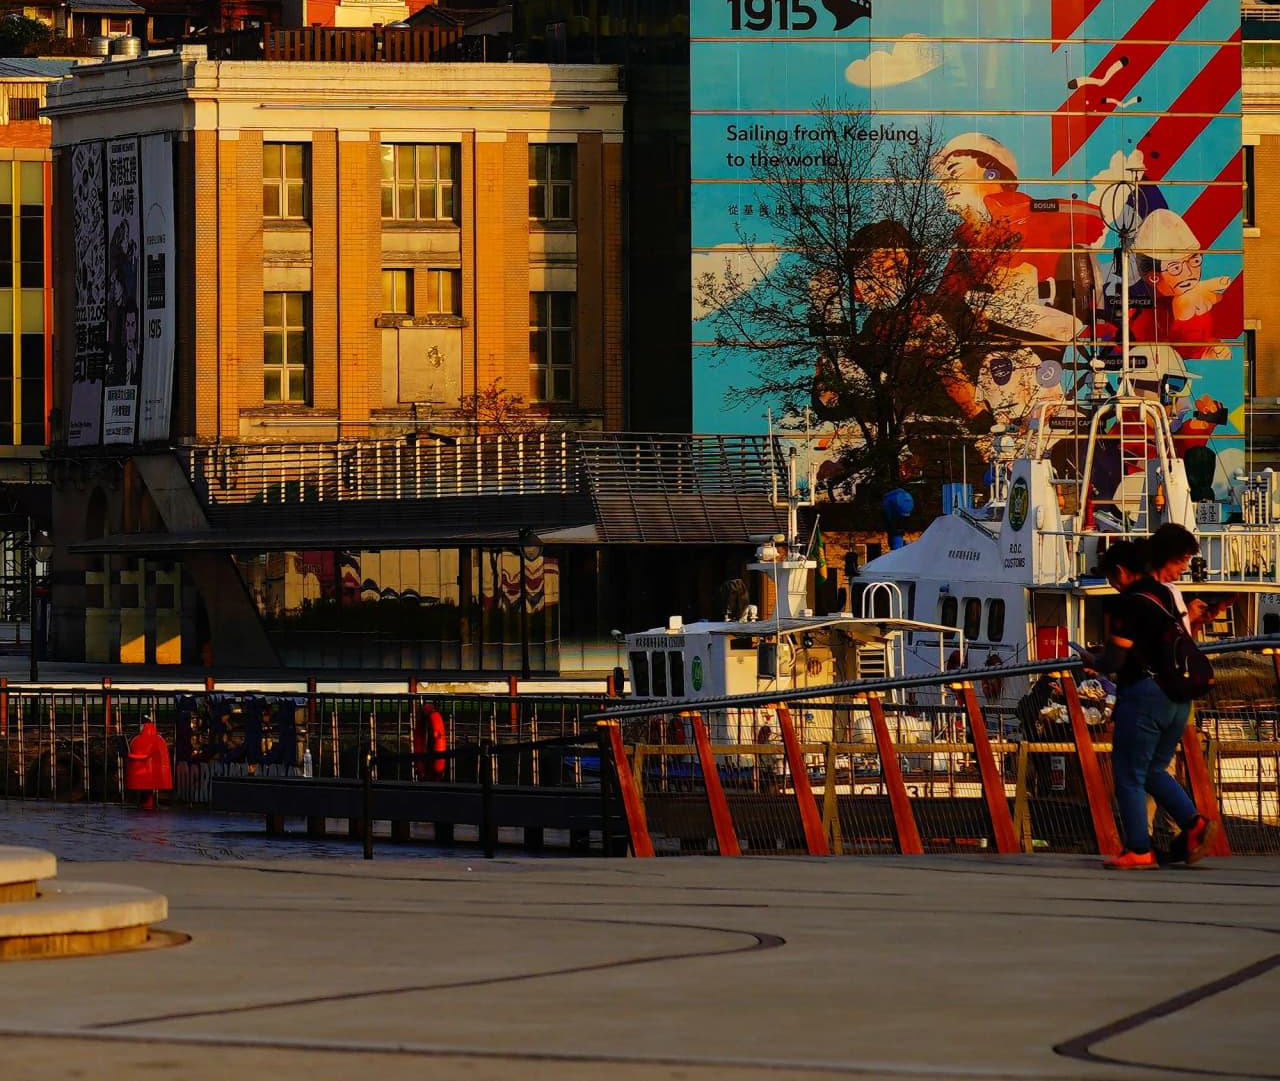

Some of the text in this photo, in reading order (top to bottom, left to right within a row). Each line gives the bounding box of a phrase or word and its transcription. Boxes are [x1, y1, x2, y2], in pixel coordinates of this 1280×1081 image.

[726, 124, 919, 146] Sailing from Keelung
[726, 152, 745, 168] to
[750, 150, 782, 168] the
[148, 318, 162, 339] 1915
[1004, 558, 1026, 568] CUSTOMS
